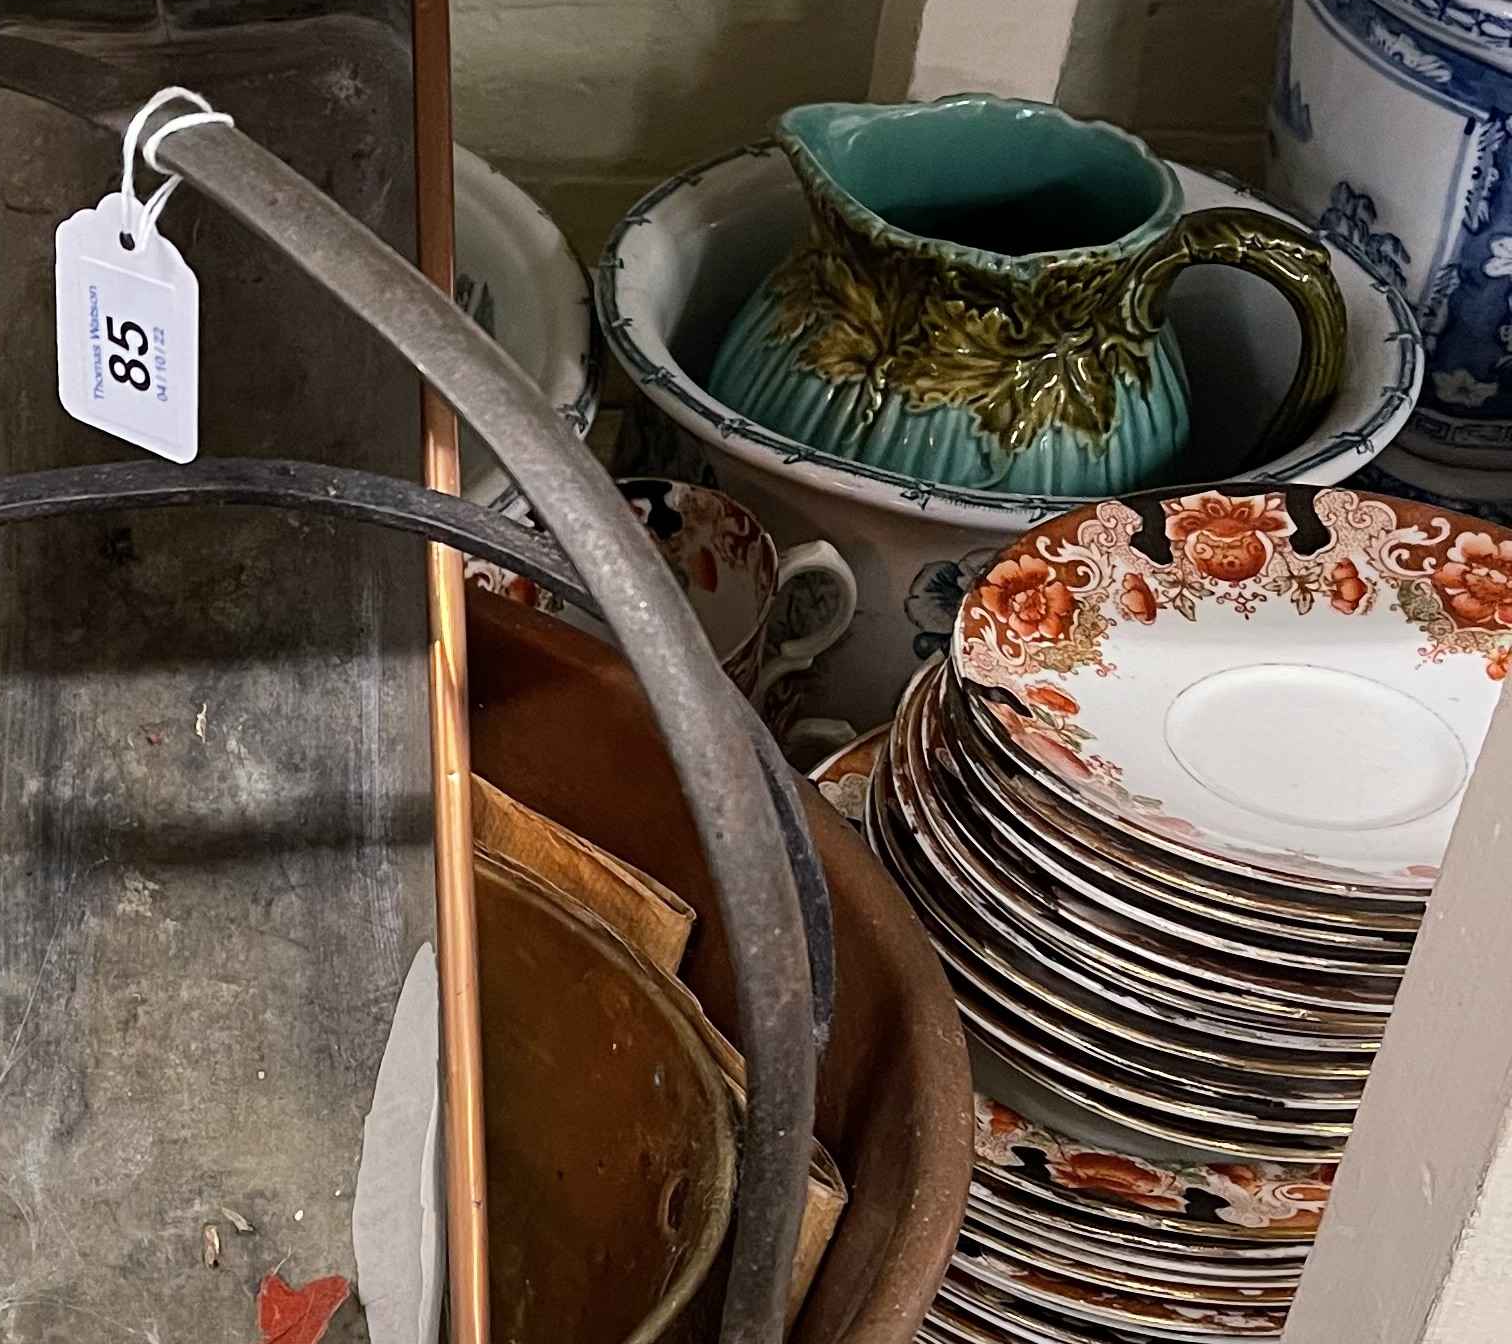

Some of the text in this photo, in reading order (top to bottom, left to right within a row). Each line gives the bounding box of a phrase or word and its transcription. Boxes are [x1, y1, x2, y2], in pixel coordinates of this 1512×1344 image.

[89, 285, 105, 400] Thomas Watson
[106, 316, 151, 392] 85
